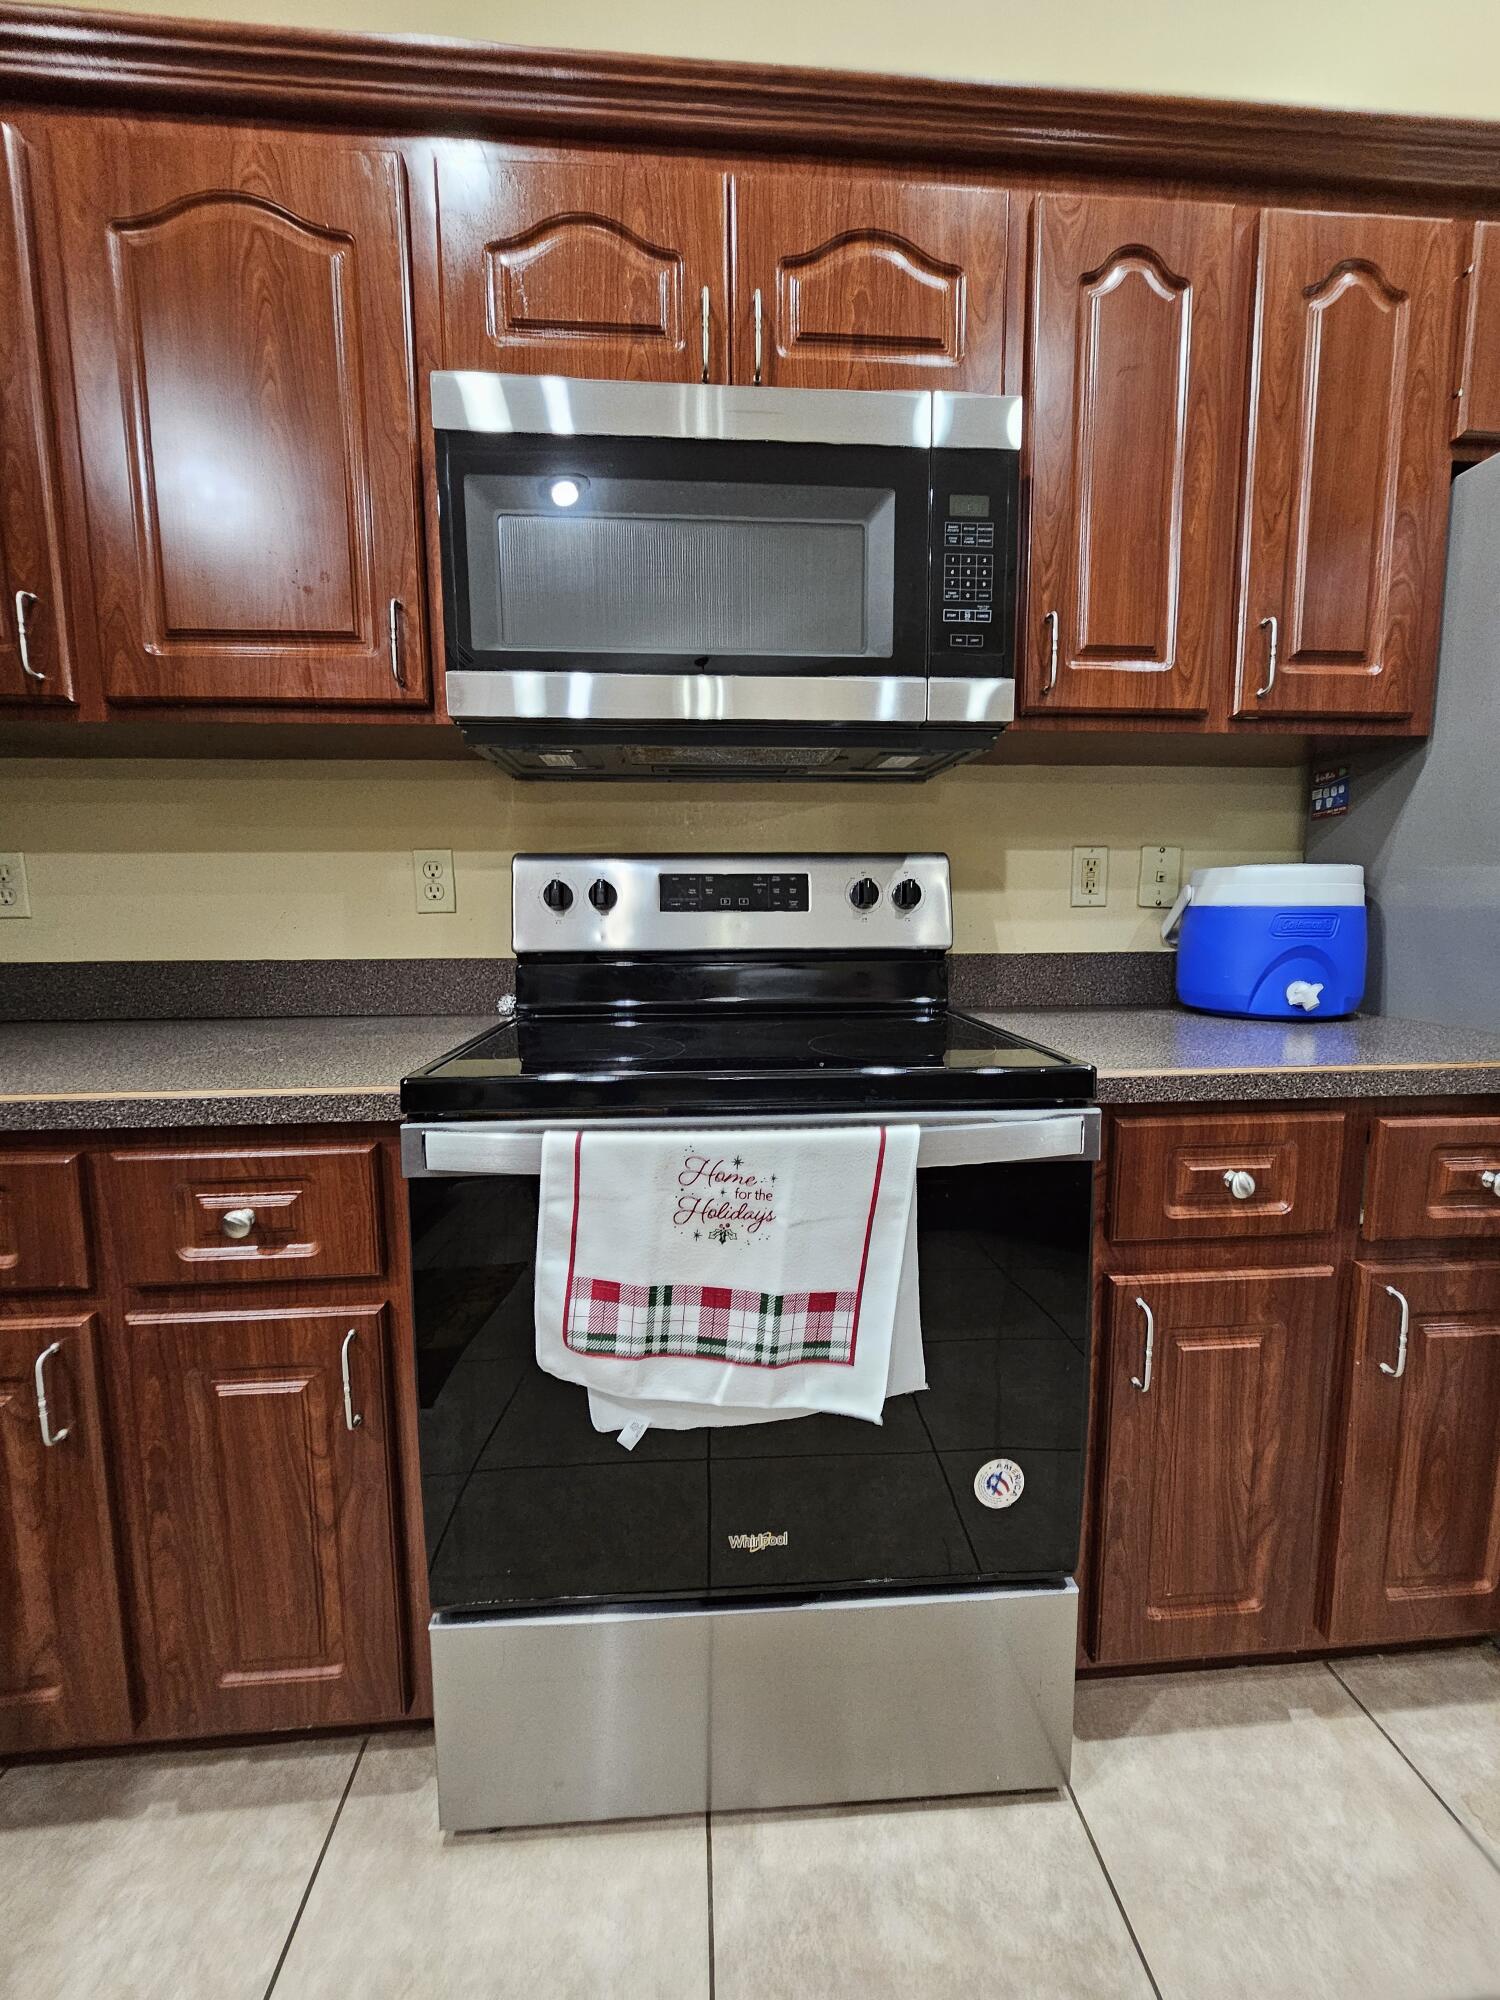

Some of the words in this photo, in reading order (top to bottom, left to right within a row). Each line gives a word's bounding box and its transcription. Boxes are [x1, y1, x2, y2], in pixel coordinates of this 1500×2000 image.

[678, 1156, 758, 1188] Home
[736, 1188, 751, 1200] for
[755, 1189, 773, 1201] the
[673, 1196, 776, 1233] Holidays
[728, 1531, 788, 1552] Whirlpool
